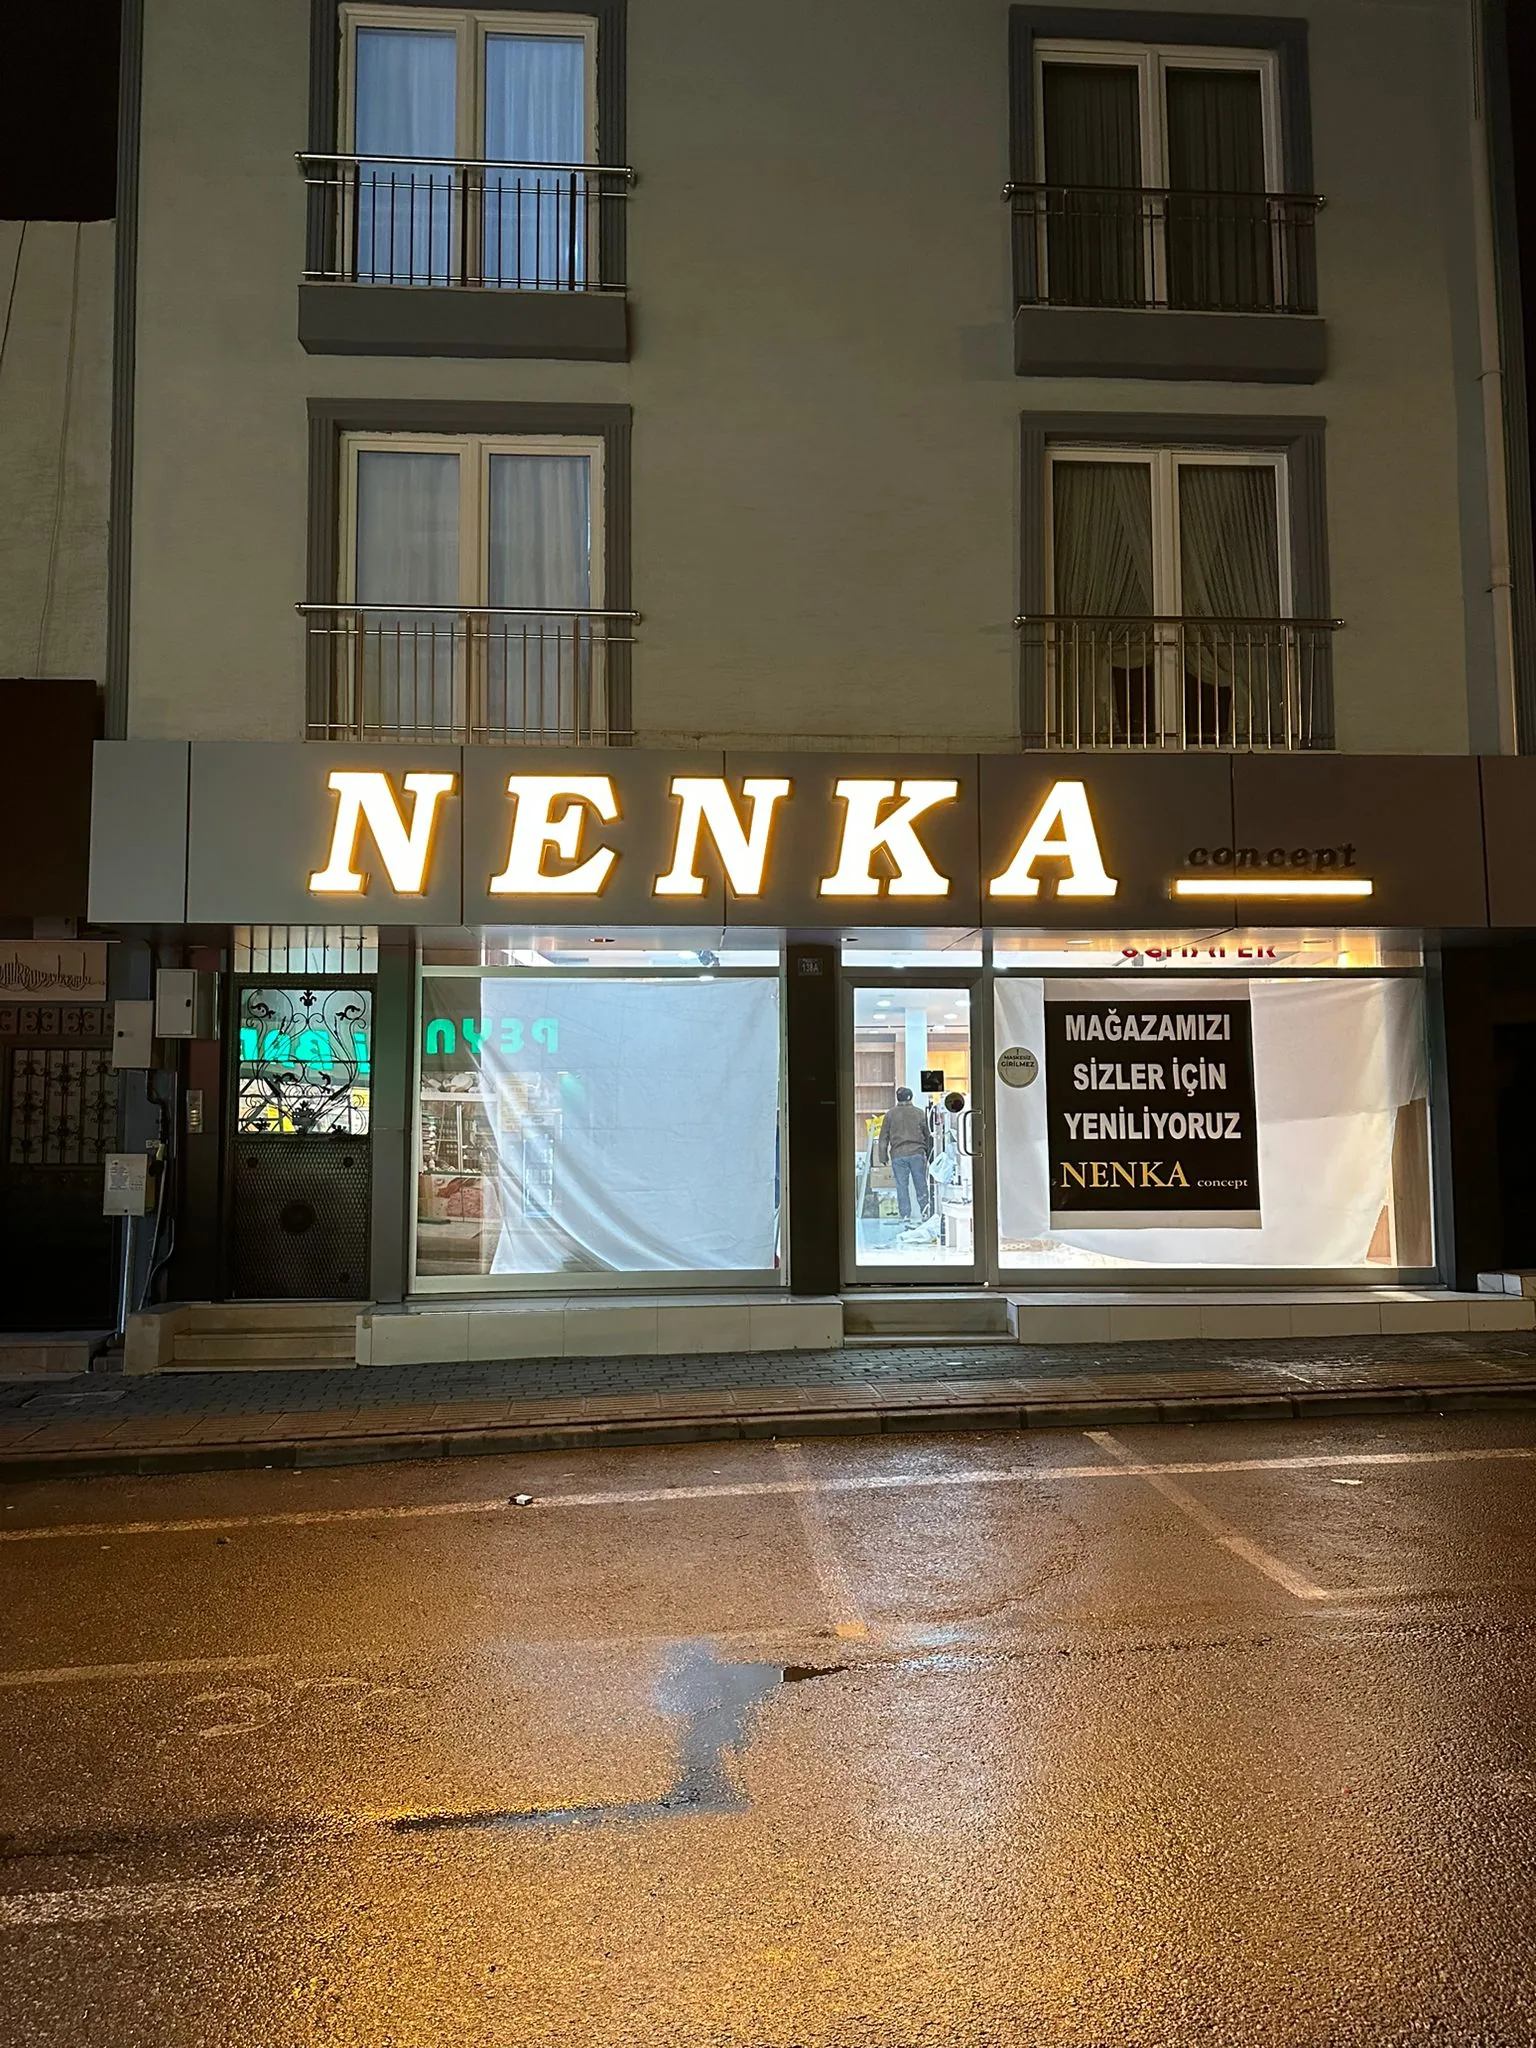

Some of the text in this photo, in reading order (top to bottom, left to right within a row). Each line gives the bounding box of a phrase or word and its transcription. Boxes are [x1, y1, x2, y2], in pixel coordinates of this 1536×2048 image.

[308, 770, 1120, 898] NENKA
[1186, 842, 1358, 875] concept
[1065, 1008, 1231, 1041] MAĞAZAMIZI
[1073, 1057, 1227, 1097] SİZLER İÇİN
[1064, 1106, 1242, 1140] YENİLİYORUZ
[1060, 1161, 1248, 1190] NENKA concept
